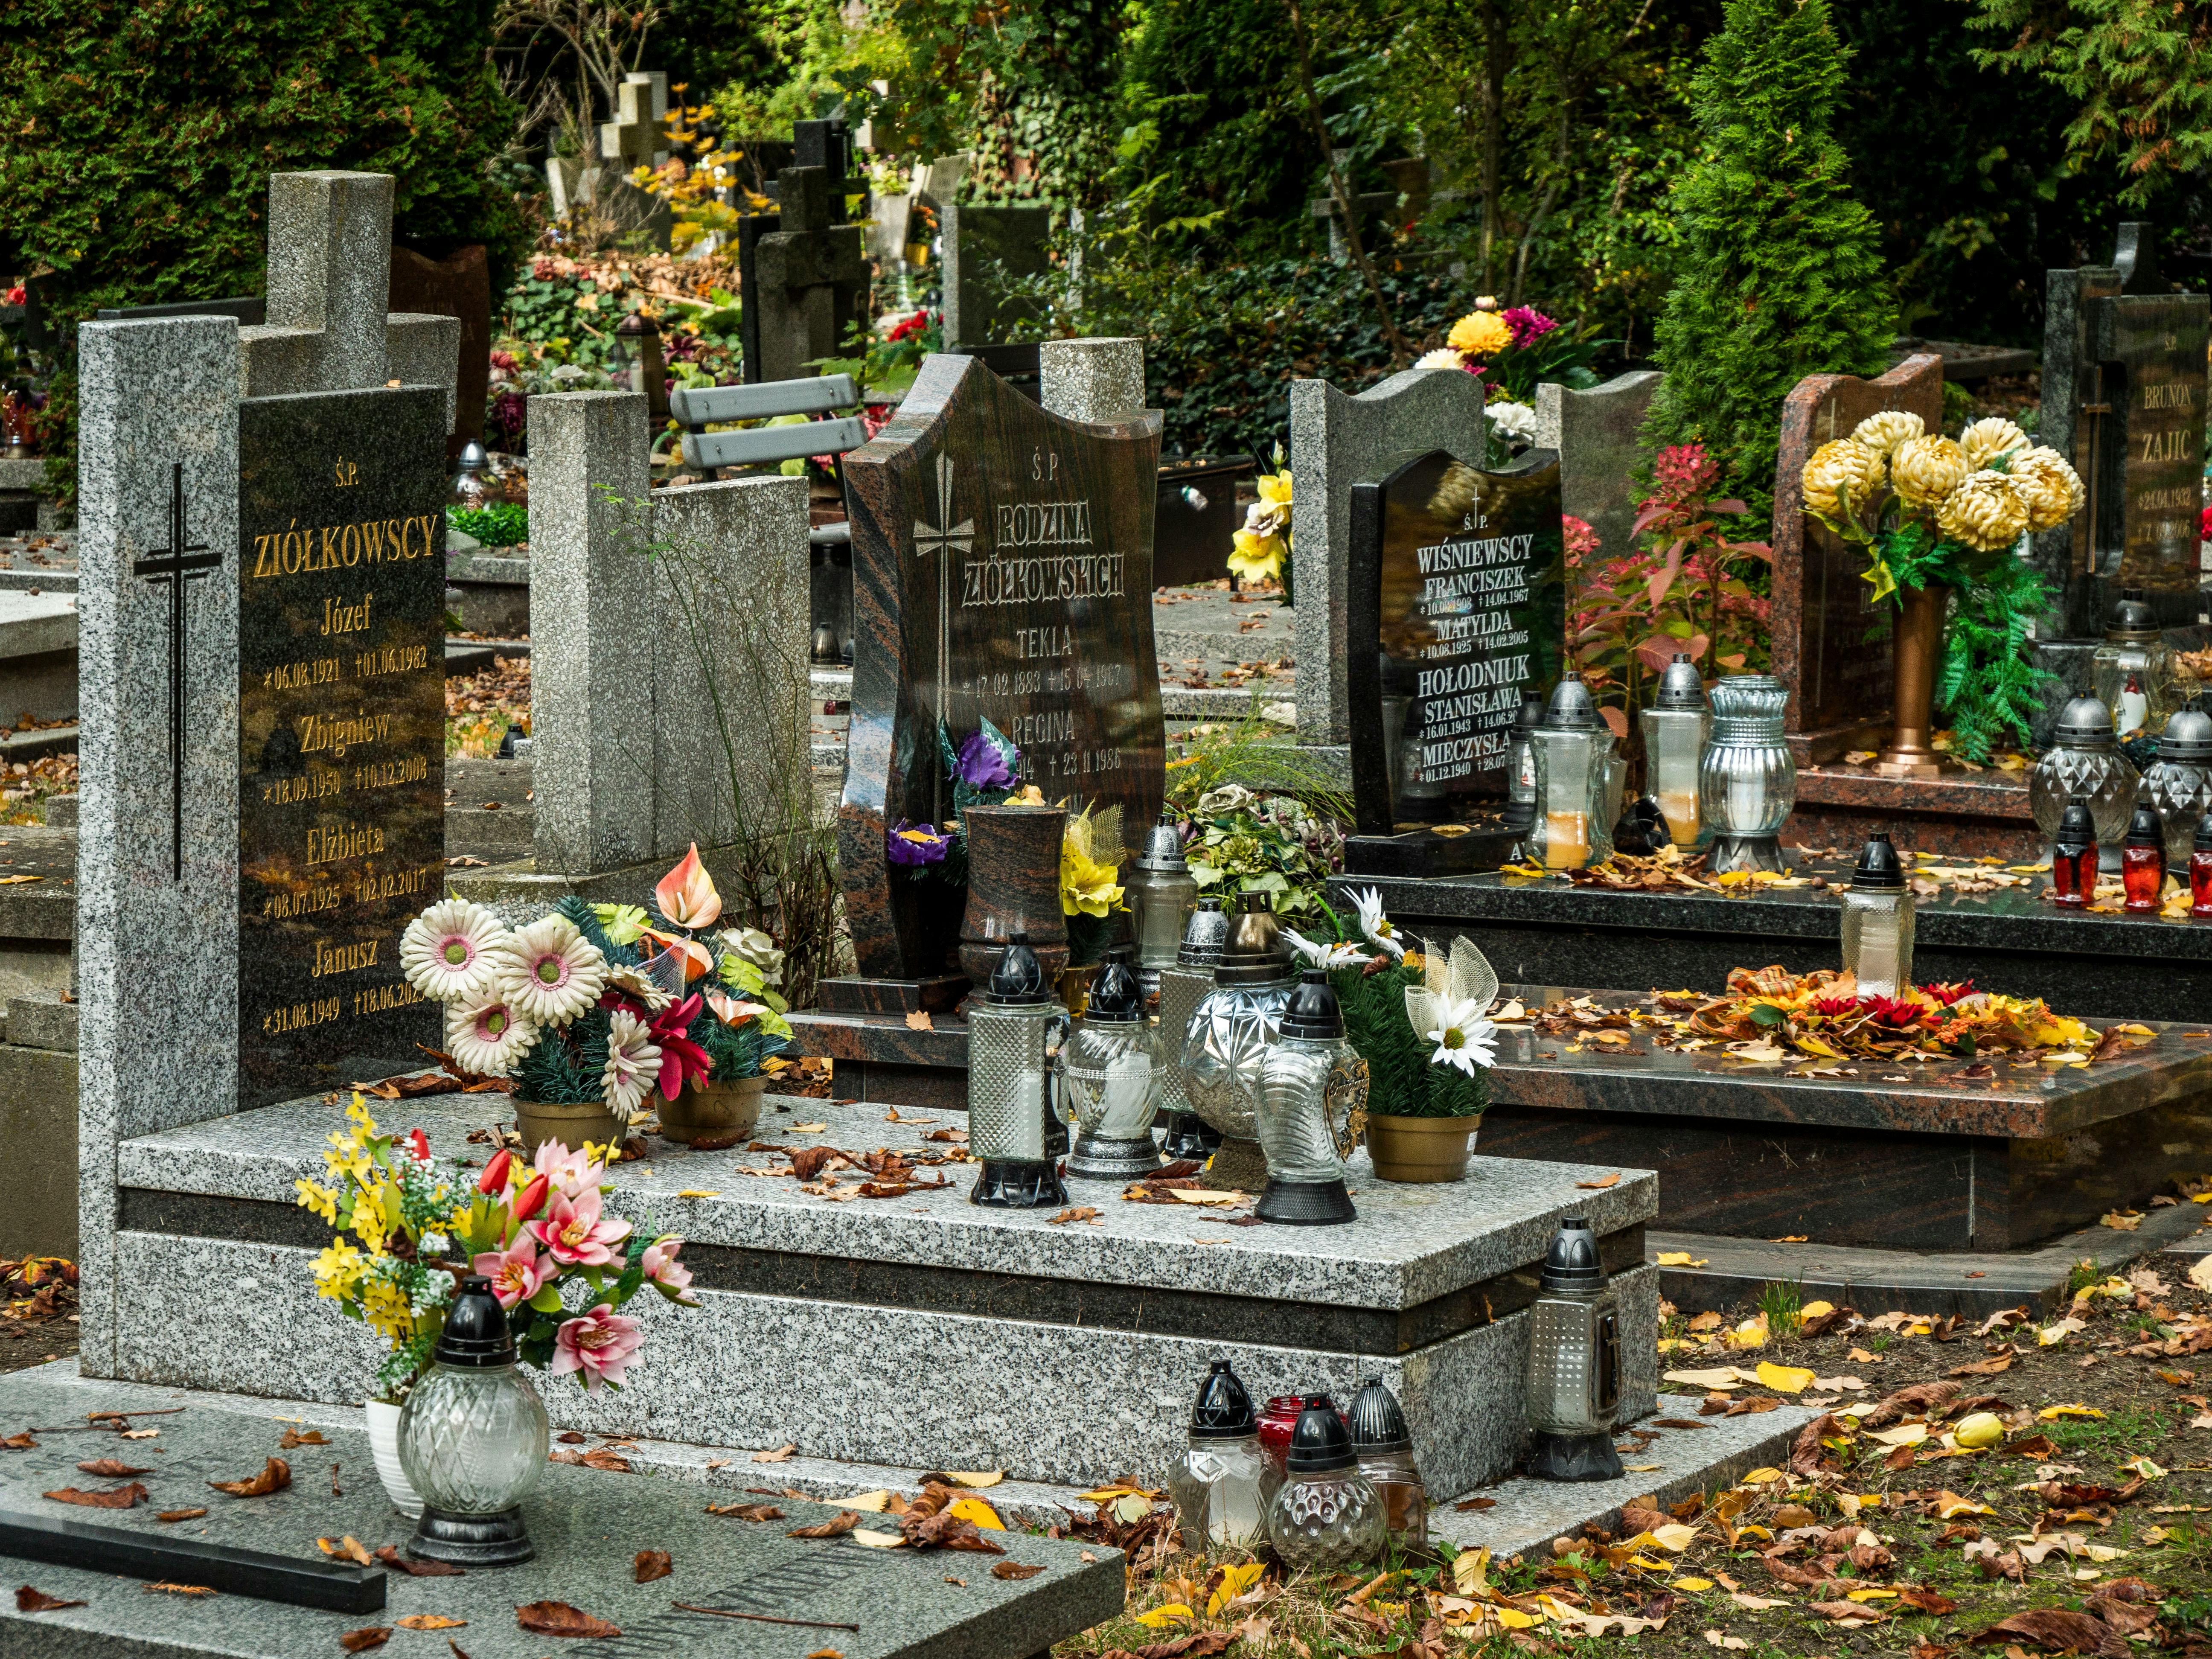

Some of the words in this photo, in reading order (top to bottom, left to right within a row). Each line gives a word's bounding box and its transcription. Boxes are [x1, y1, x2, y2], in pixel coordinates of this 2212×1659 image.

[2144, 384, 2192, 409] BRUNON
[2142, 429, 2191, 462] ZAJIC
[335, 455, 358, 486] Ś.P.
[997, 498, 1093, 547] RODZINA
[253, 515, 437, 578] ZIÓŁKOWSCY
[1417, 534, 1533, 573] WIŚNIEWSCY
[961, 551, 1125, 608] ZIÓŁKOWSKICH
[1424, 566, 1526, 600] FRANCISZEK
[1485, 588, 1529, 606] 14.04.1967
[321, 594, 372, 635] Józef
[1436, 610, 1513, 641] MATYLDA
[1016, 626, 1072, 658] TEKLA
[1485, 630, 1529, 649] 14.02.2005
[274, 658, 340, 690] 06.08.1921
[363, 645, 426, 676] 01.06.1982
[1418, 654, 1530, 698] HOŁODNIUK
[1425, 687, 1522, 724] STANISŁAWA
[300, 709, 391, 757] Zbigniew
[1012, 710, 1075, 746] REGINA
[1426, 719, 1471, 739] 16.01.1943
[1484, 710, 1518, 728] 14.06.20
[1423, 730, 1511, 767] MIECZYSŁA
[274, 771, 340, 804] 18.09.1950
[1426, 762, 1471, 782] 01.12.1940
[306, 826, 384, 865] Elżbieta
[274, 884, 340, 919] 08.07.1925
[311, 940, 378, 978] Janusz
[274, 997, 339, 1033] 31.08.1949
